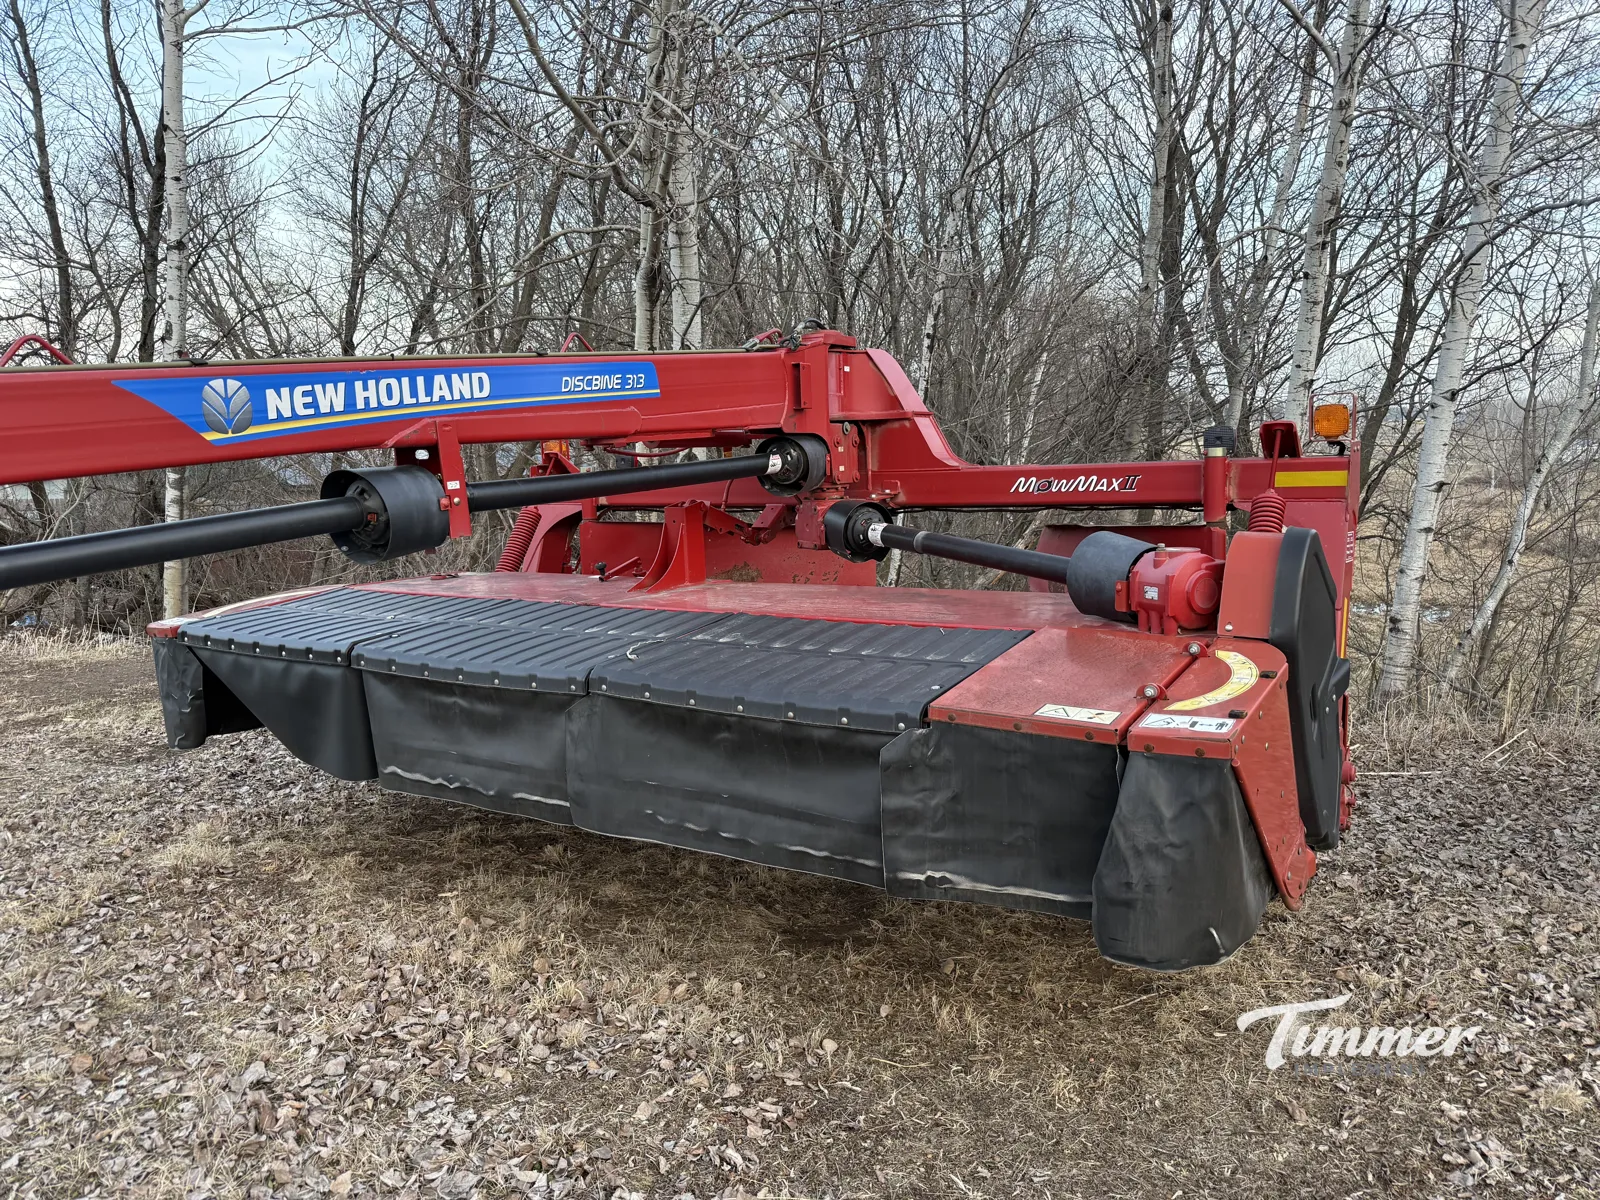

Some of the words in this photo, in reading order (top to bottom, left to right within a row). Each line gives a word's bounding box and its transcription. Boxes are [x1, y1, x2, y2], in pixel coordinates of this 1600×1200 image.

[265, 382, 346, 420] NEW
[354, 371, 491, 410] HOLLAND
[561, 374, 622, 392] DISCBINE
[625, 373, 645, 389] 313
